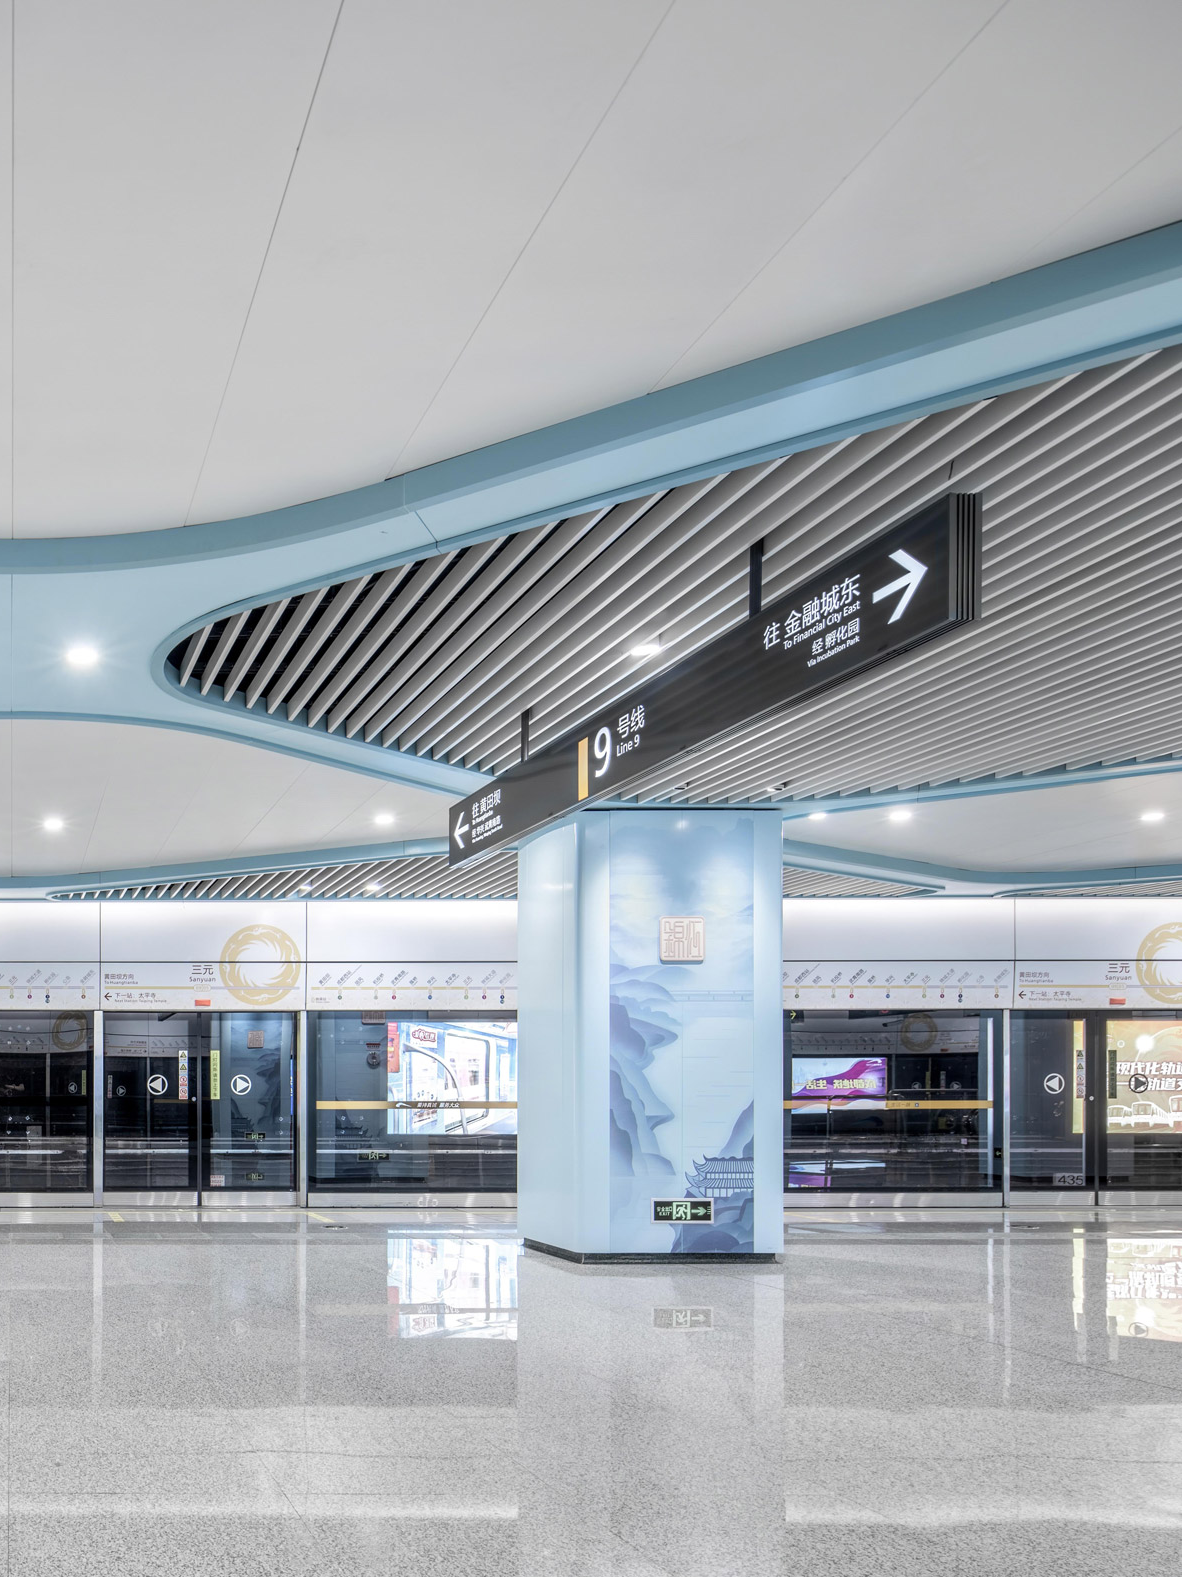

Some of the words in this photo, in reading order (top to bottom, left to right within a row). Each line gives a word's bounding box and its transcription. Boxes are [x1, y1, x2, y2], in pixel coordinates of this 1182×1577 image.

[763, 622, 780, 650] 往
[784, 574, 860, 638] 金融城东
[783, 640, 792, 650] To
[793, 618, 826, 645] Financial
[826, 611, 842, 626] City
[844, 600, 860, 617] East
[807, 658, 816, 668] Via
[817, 644, 846, 663] Incubation
[846, 635, 860, 648] Park
[812, 638, 824, 656] 经
[825, 618, 860, 650] 孵化园
[594, 726, 612, 778] 9
[617, 704, 645, 739] 号线
[617, 742, 633, 757] Line
[634, 734, 640, 748] 9
[192, 964, 214, 975] 三元
[1108, 963, 1130, 973] 三元
